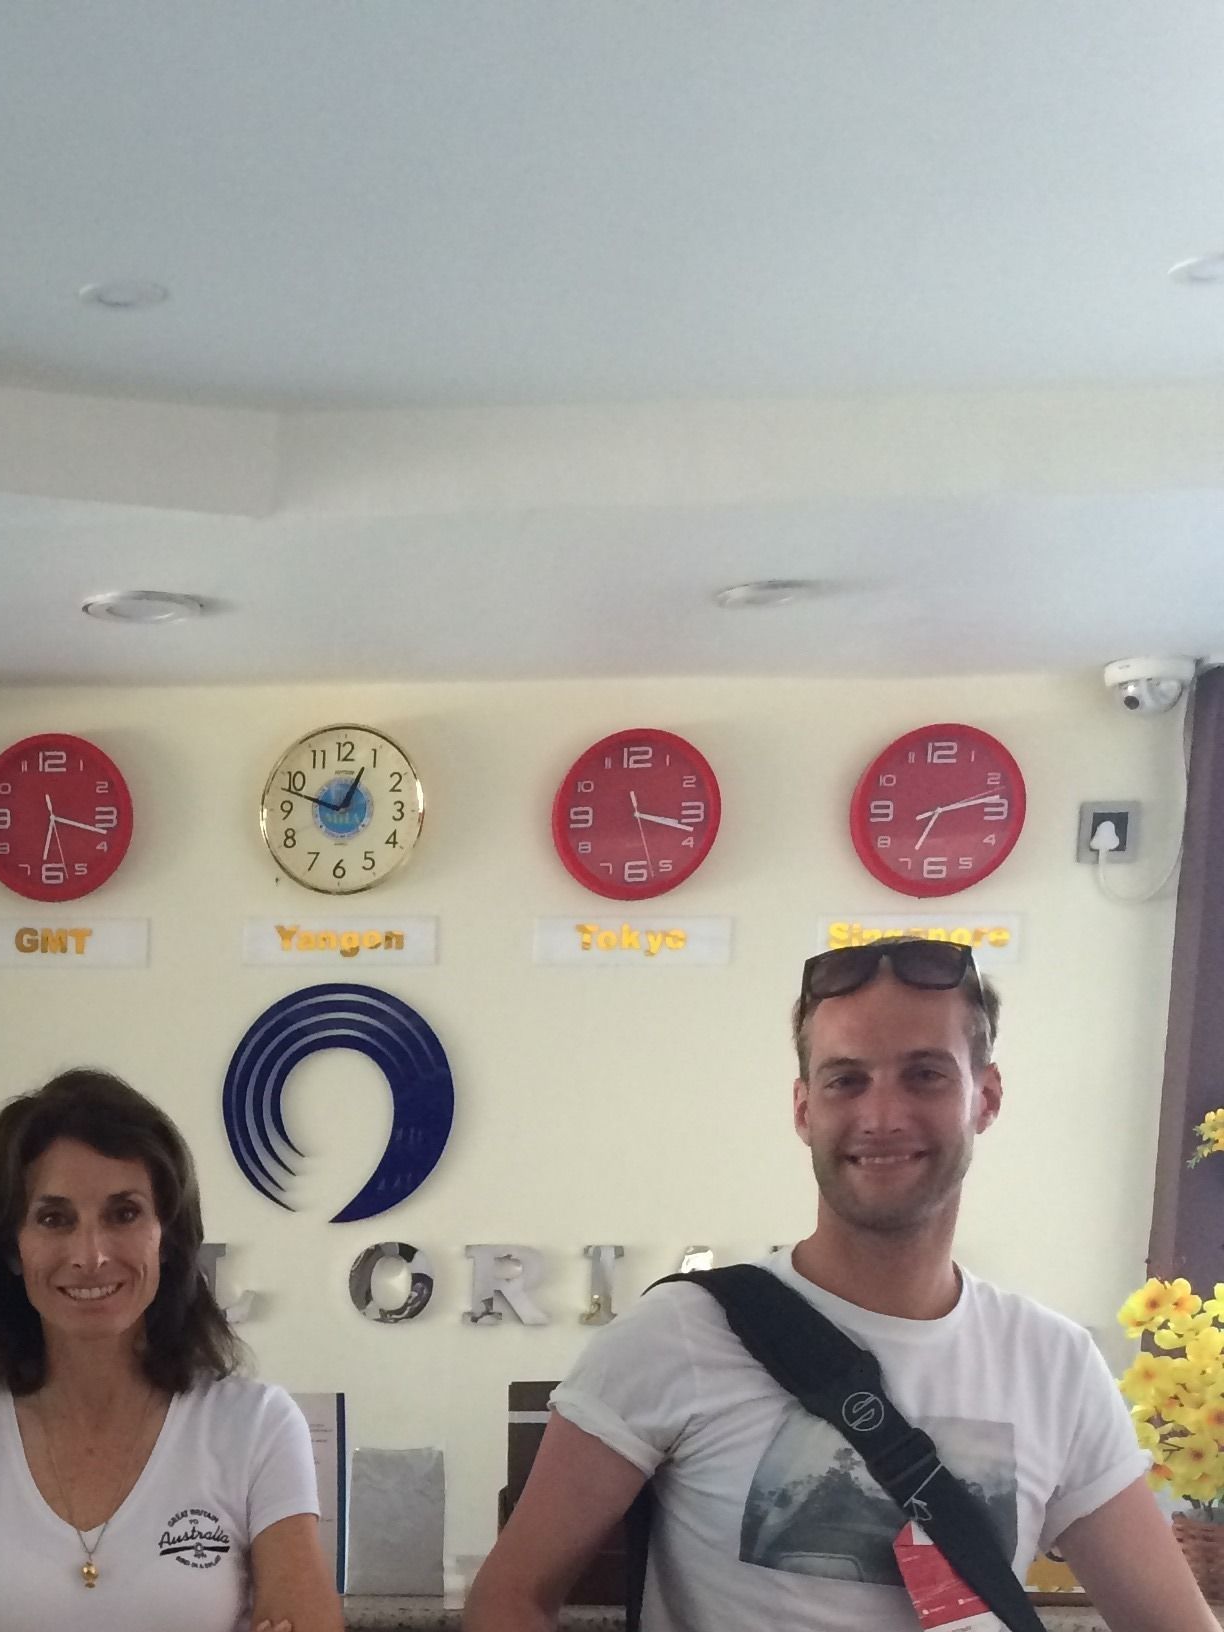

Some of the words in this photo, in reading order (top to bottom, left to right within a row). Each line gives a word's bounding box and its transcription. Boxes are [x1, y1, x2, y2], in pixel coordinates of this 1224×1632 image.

[311, 749, 326, 769] 11
[336, 741, 355, 762] 12
[371, 748, 377, 768] 1
[623, 746, 653, 769] 12
[927, 741, 958, 764] 12
[38, 751, 67, 773] 12
[95, 781, 109, 793] 2
[287, 771, 306, 792] 10
[389, 772, 403, 793] 2
[577, 780, 594, 792] 10
[683, 775, 696, 788] 2
[879, 774, 896, 787] 10
[987, 772, 1001, 785] 2
[95, 807, 117, 828] 3
[280, 800, 294, 821] 9
[392, 800, 405, 822] 3
[569, 806, 593, 829] 9
[681, 801, 705, 823] 3
[869, 800, 894, 823] 9
[983, 798, 1009, 821] 3
[96, 841, 108, 852] 4
[283, 828, 296, 849] 8
[385, 829, 398, 849] 4
[578, 841, 592, 854] 8
[681, 836, 694, 848] 4
[877, 836, 891, 848] 8
[983, 834, 996, 846] 4
[18, 864, 30, 876] 7
[74, 863, 88, 875] 5
[307, 852, 320, 872] 7
[332, 859, 346, 879] 6
[362, 851, 376, 871] 5
[600, 863, 612, 875] 7
[624, 860, 648, 882] 6
[659, 859, 673, 872] 5
[898, 858, 912, 870] 7
[923, 857, 947, 879] 6
[958, 857, 973, 870] 5
[41, 863, 64, 884] 6
[15, 927, 93, 954] GMT
[275, 923, 405, 958] Yangon
[574, 922, 687, 957] Tokyo
[158, 1525, 230, 1549] Australia
